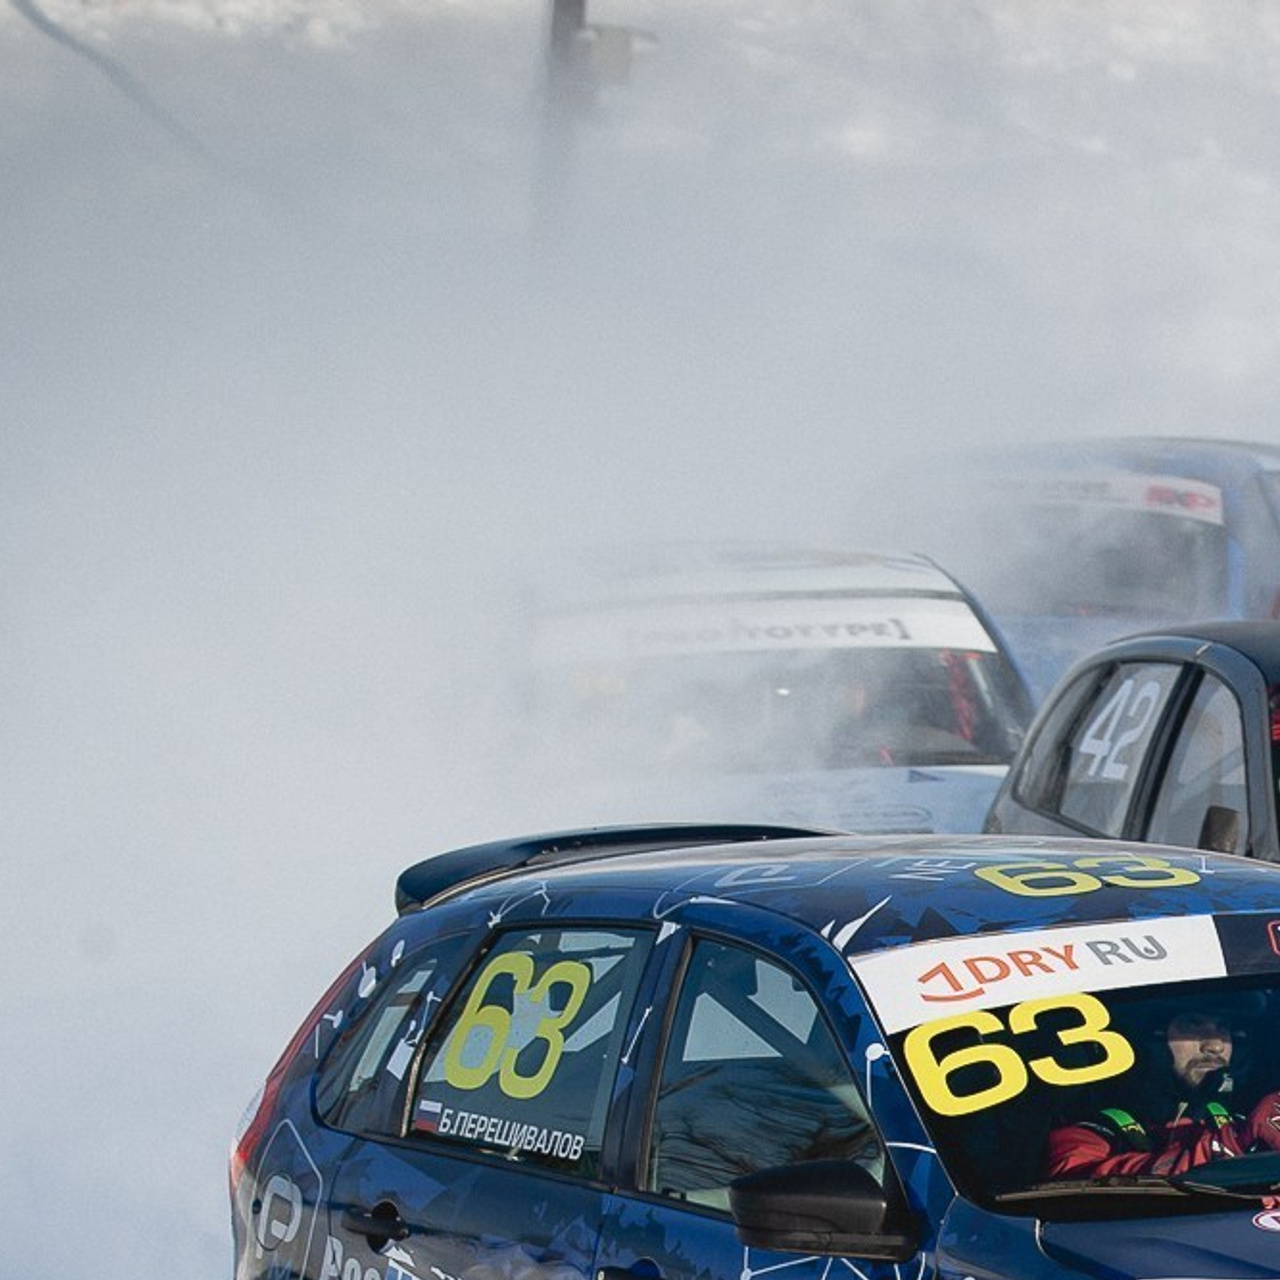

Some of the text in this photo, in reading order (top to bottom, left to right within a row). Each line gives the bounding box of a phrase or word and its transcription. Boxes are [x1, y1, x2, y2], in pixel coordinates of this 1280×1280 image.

[1080, 678, 1161, 780] 42
[973, 856, 1202, 897] 63
[1086, 935, 1168, 966] RU
[445, 952, 591, 1099] 63
[903, 992, 1135, 1117] 63
[438, 1108, 586, 1160] Б.ПЕРЕШИВАЛОВ
